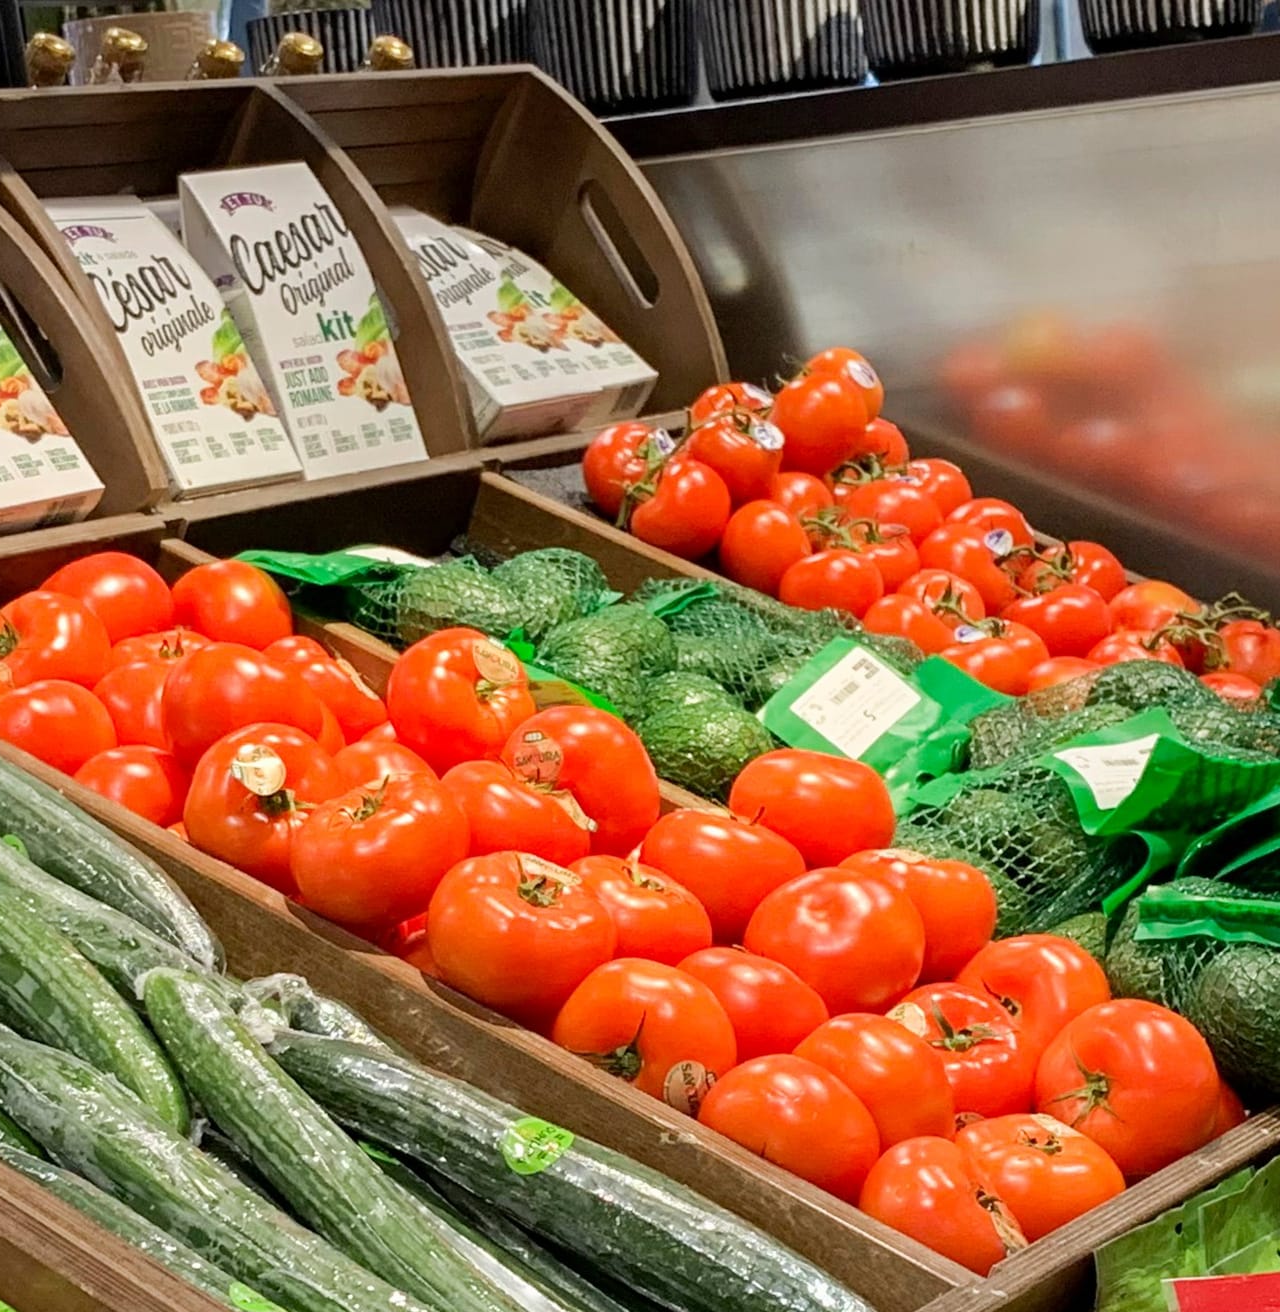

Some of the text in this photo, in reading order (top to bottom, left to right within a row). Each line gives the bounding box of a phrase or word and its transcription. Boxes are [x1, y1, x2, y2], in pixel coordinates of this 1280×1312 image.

[231, 201, 350, 295] Caesar
[280, 261, 355, 315] Original
[141, 294, 215, 357] originale
[316, 310, 357, 342] kit
[284, 366, 329, 389] JUST ADD
[289, 385, 335, 408] ROMAINE
